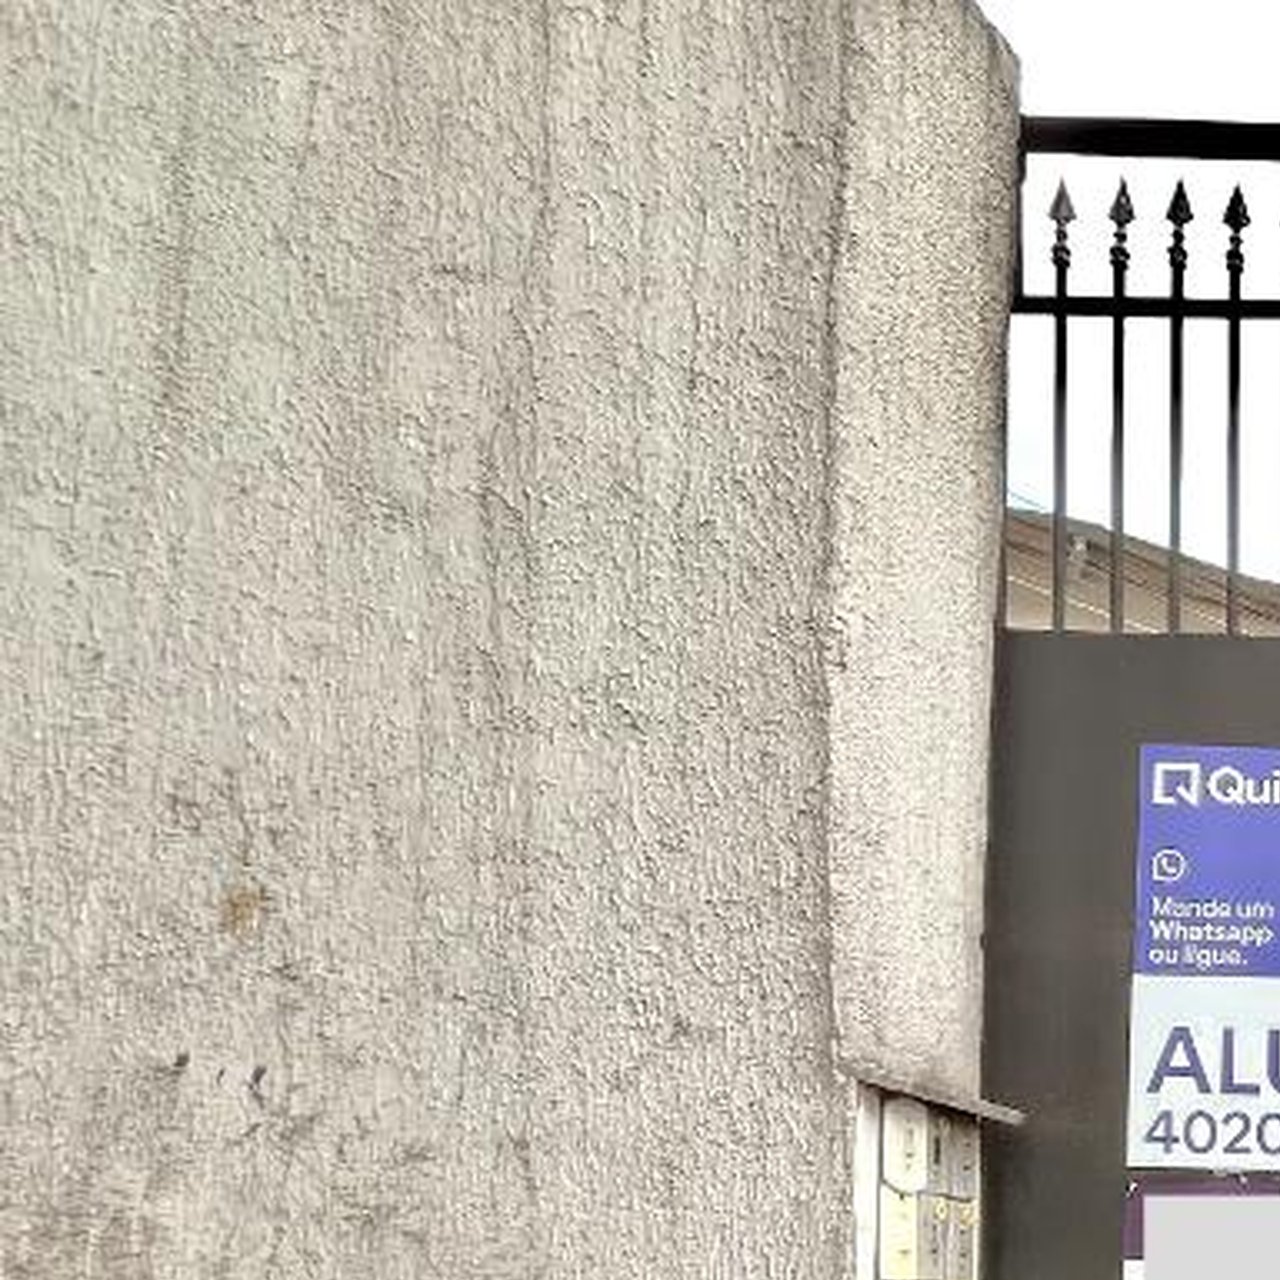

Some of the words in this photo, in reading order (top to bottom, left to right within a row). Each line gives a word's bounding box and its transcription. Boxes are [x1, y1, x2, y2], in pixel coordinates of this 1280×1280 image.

[1152, 896, 1231, 919] Manda
[1236, 902, 1275, 919] um
[1149, 949, 1179, 964] ou
